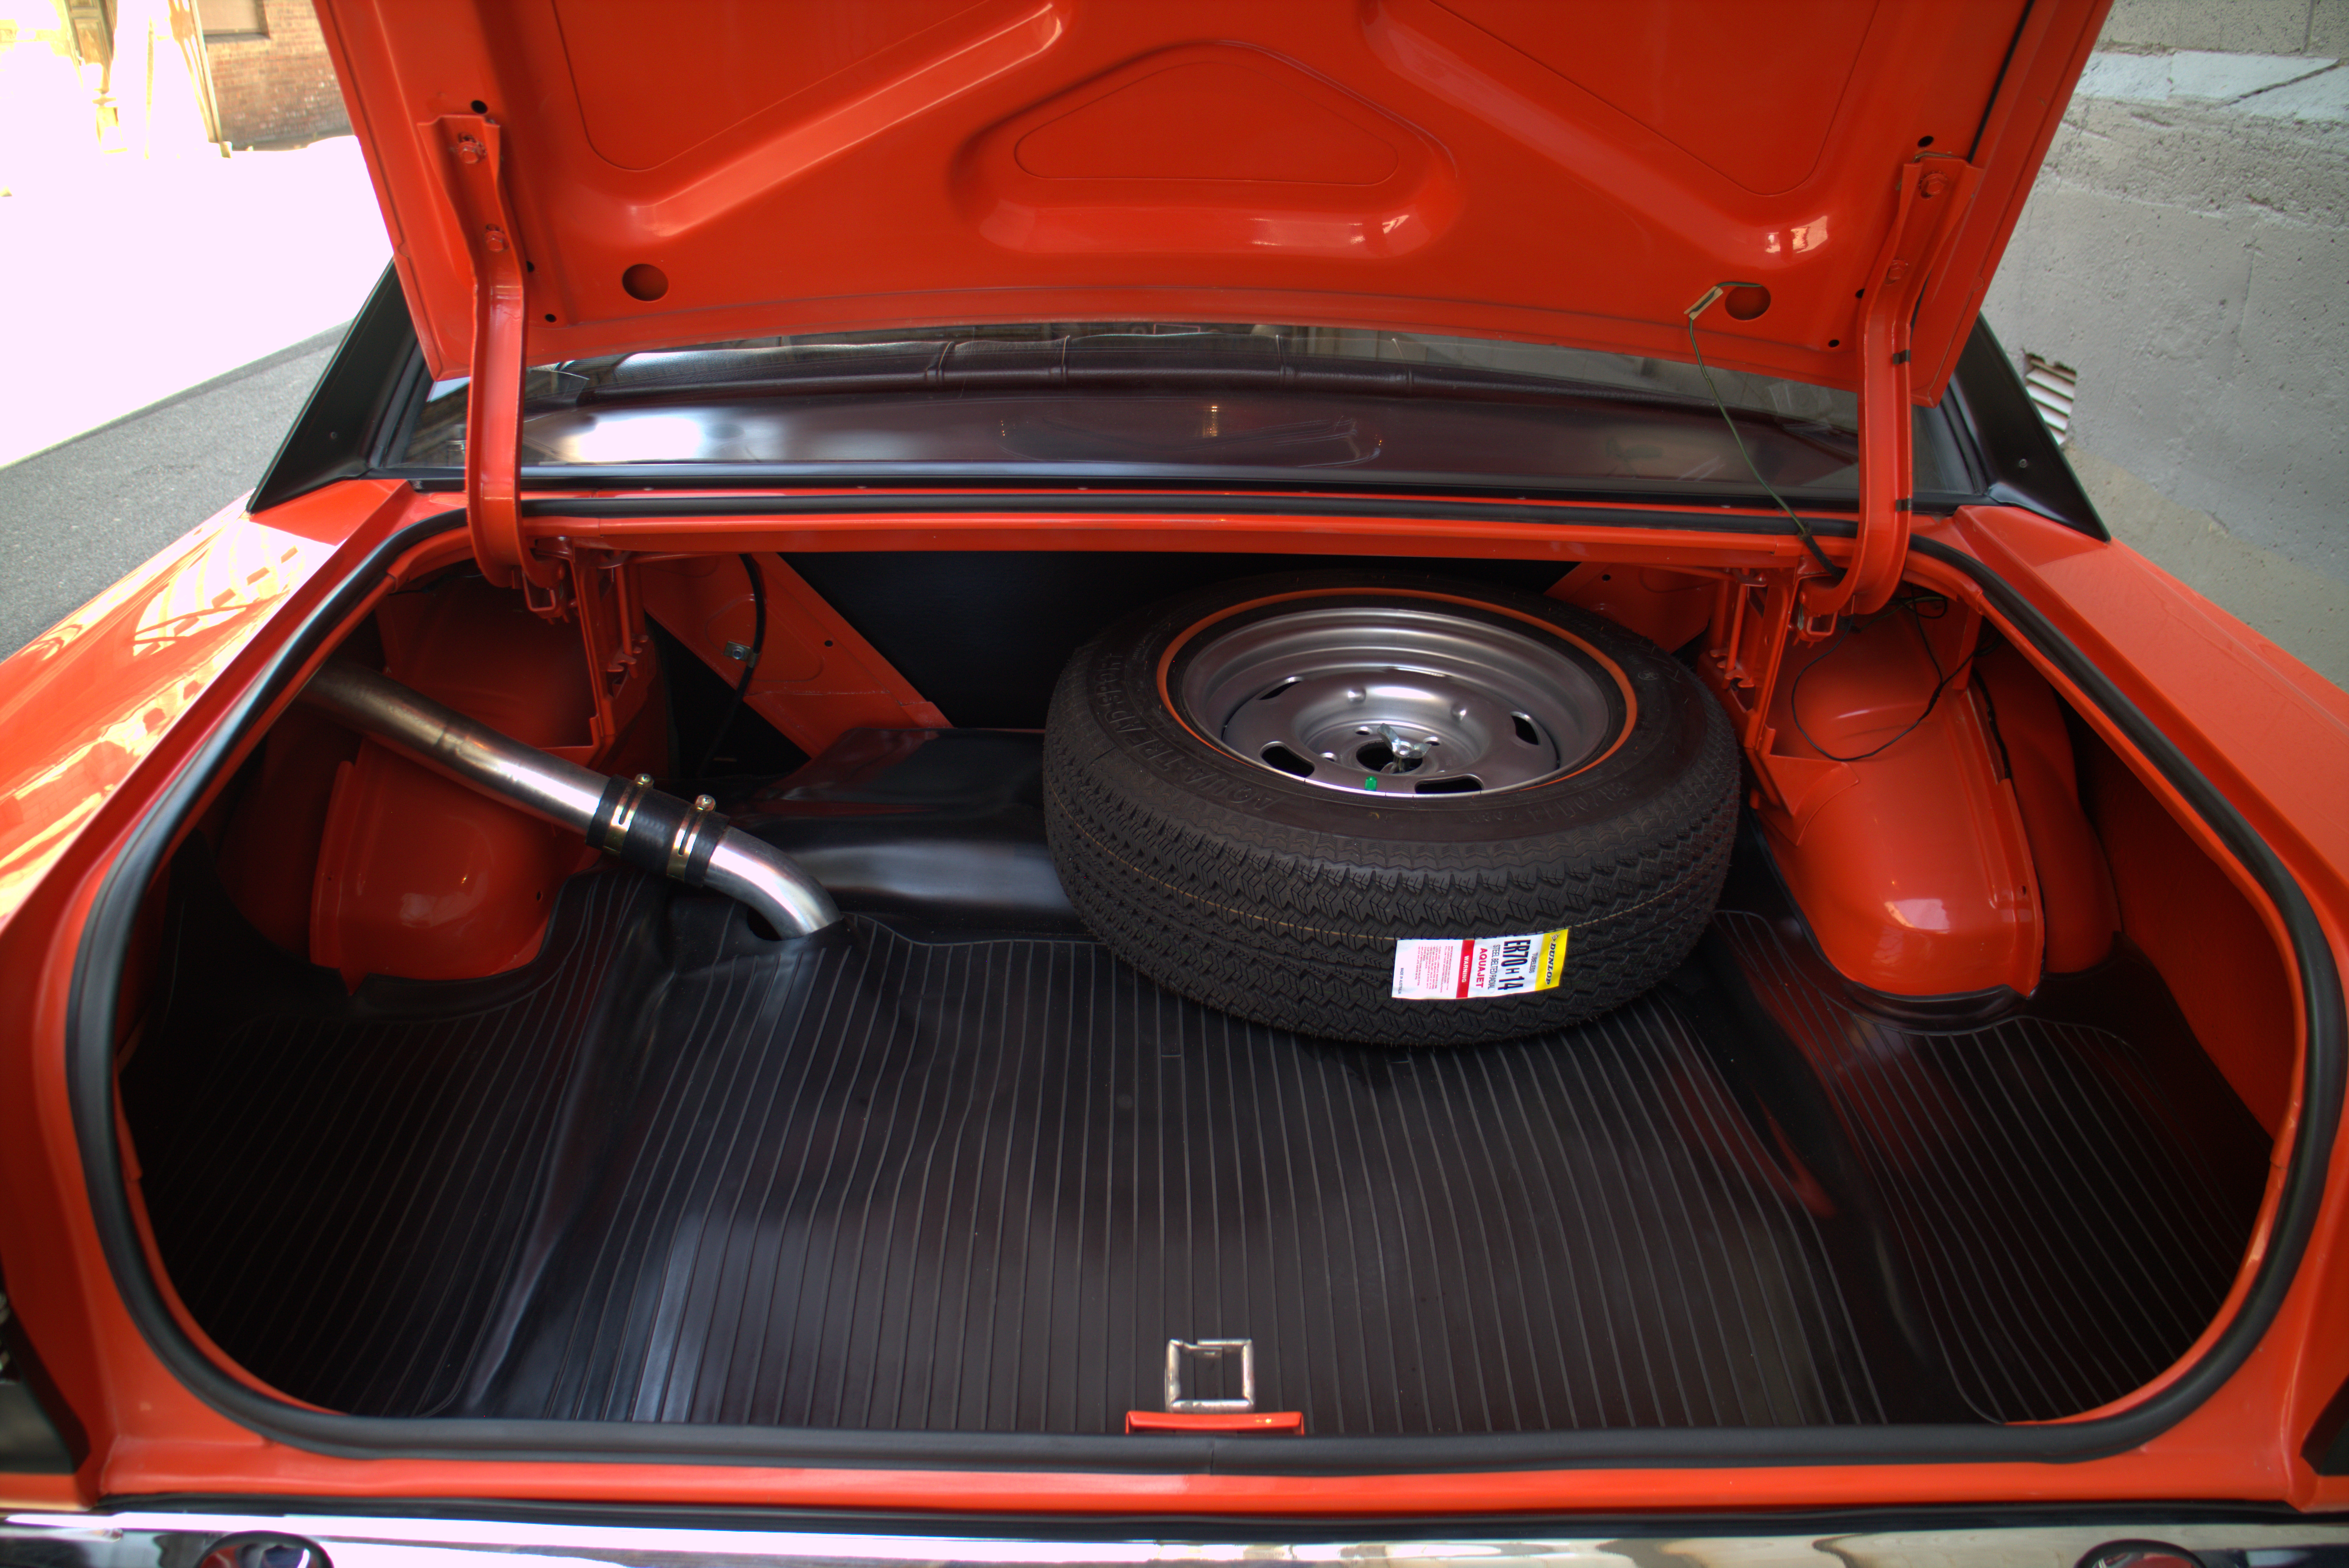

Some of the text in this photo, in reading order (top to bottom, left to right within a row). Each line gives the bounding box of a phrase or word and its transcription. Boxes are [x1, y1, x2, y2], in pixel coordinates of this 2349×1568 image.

[1476, 948, 1487, 988] AQUAJET
[1487, 945, 1500, 990] STEEL BELTED RADIAL
[1529, 952, 1538, 973] TUBELESS
[1546, 943, 1556, 985] DUNLOP
